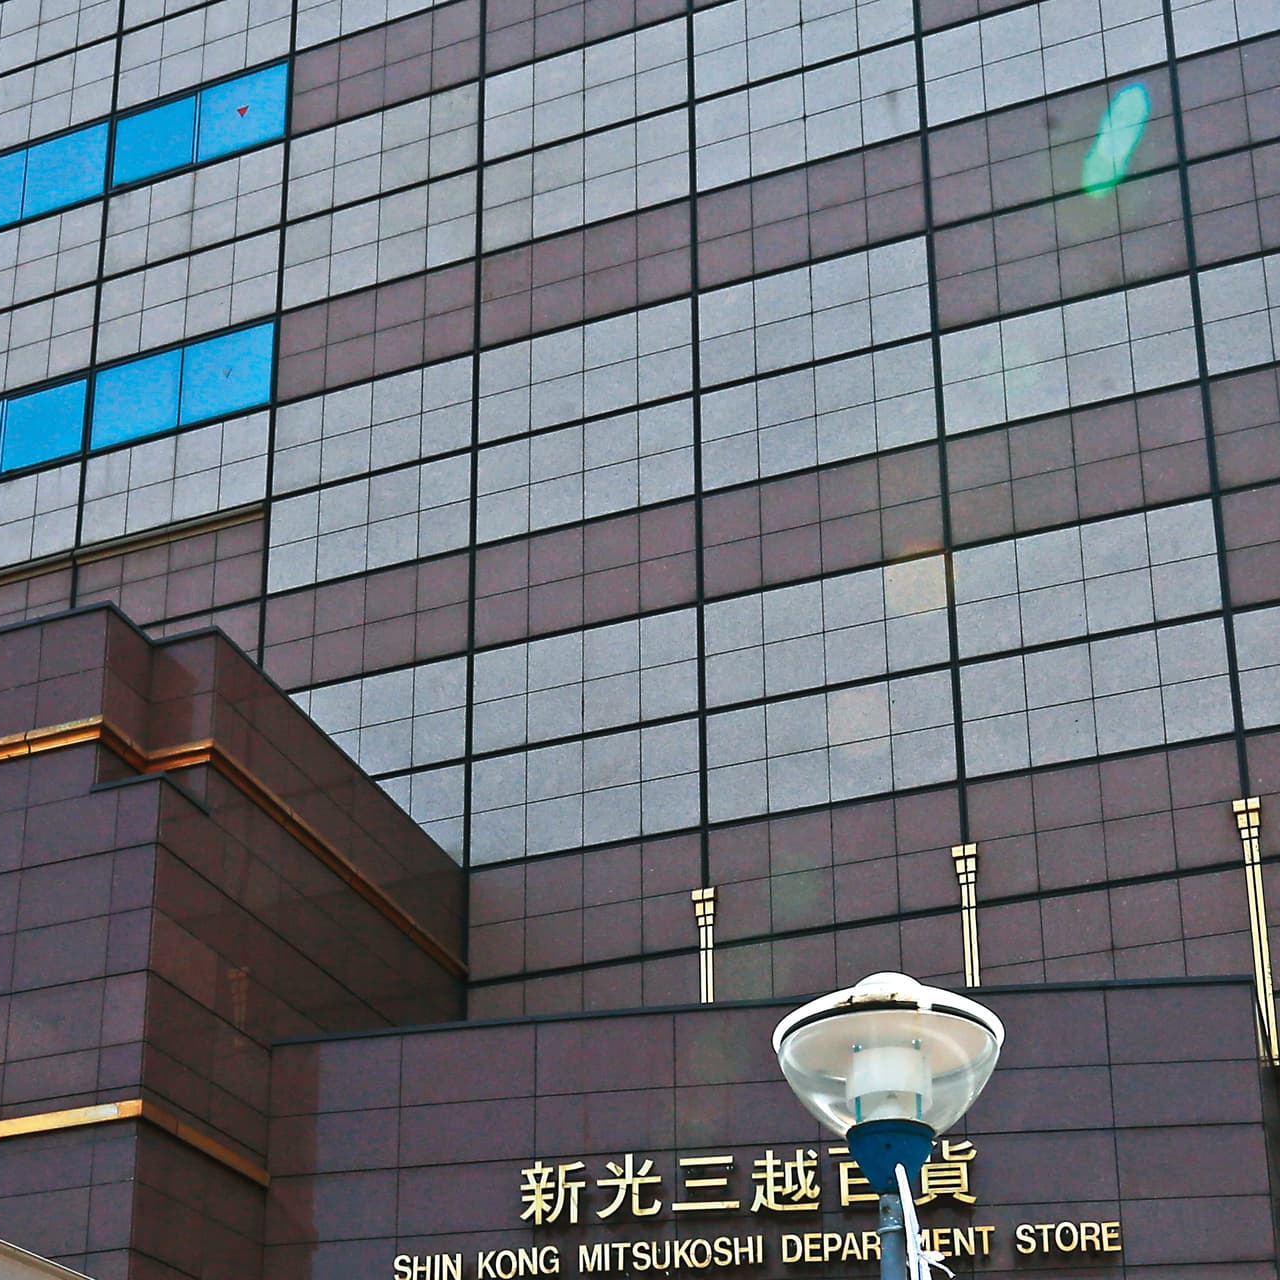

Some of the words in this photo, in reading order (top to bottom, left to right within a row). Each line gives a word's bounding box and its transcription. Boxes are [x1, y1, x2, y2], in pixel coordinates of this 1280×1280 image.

[477, 1247, 560, 1280] KONG
[577, 1235, 764, 1273] MITSUKOSHI
[781, 1226, 996, 1264] DEPARENT
[1015, 1220, 1122, 1254] STORE
